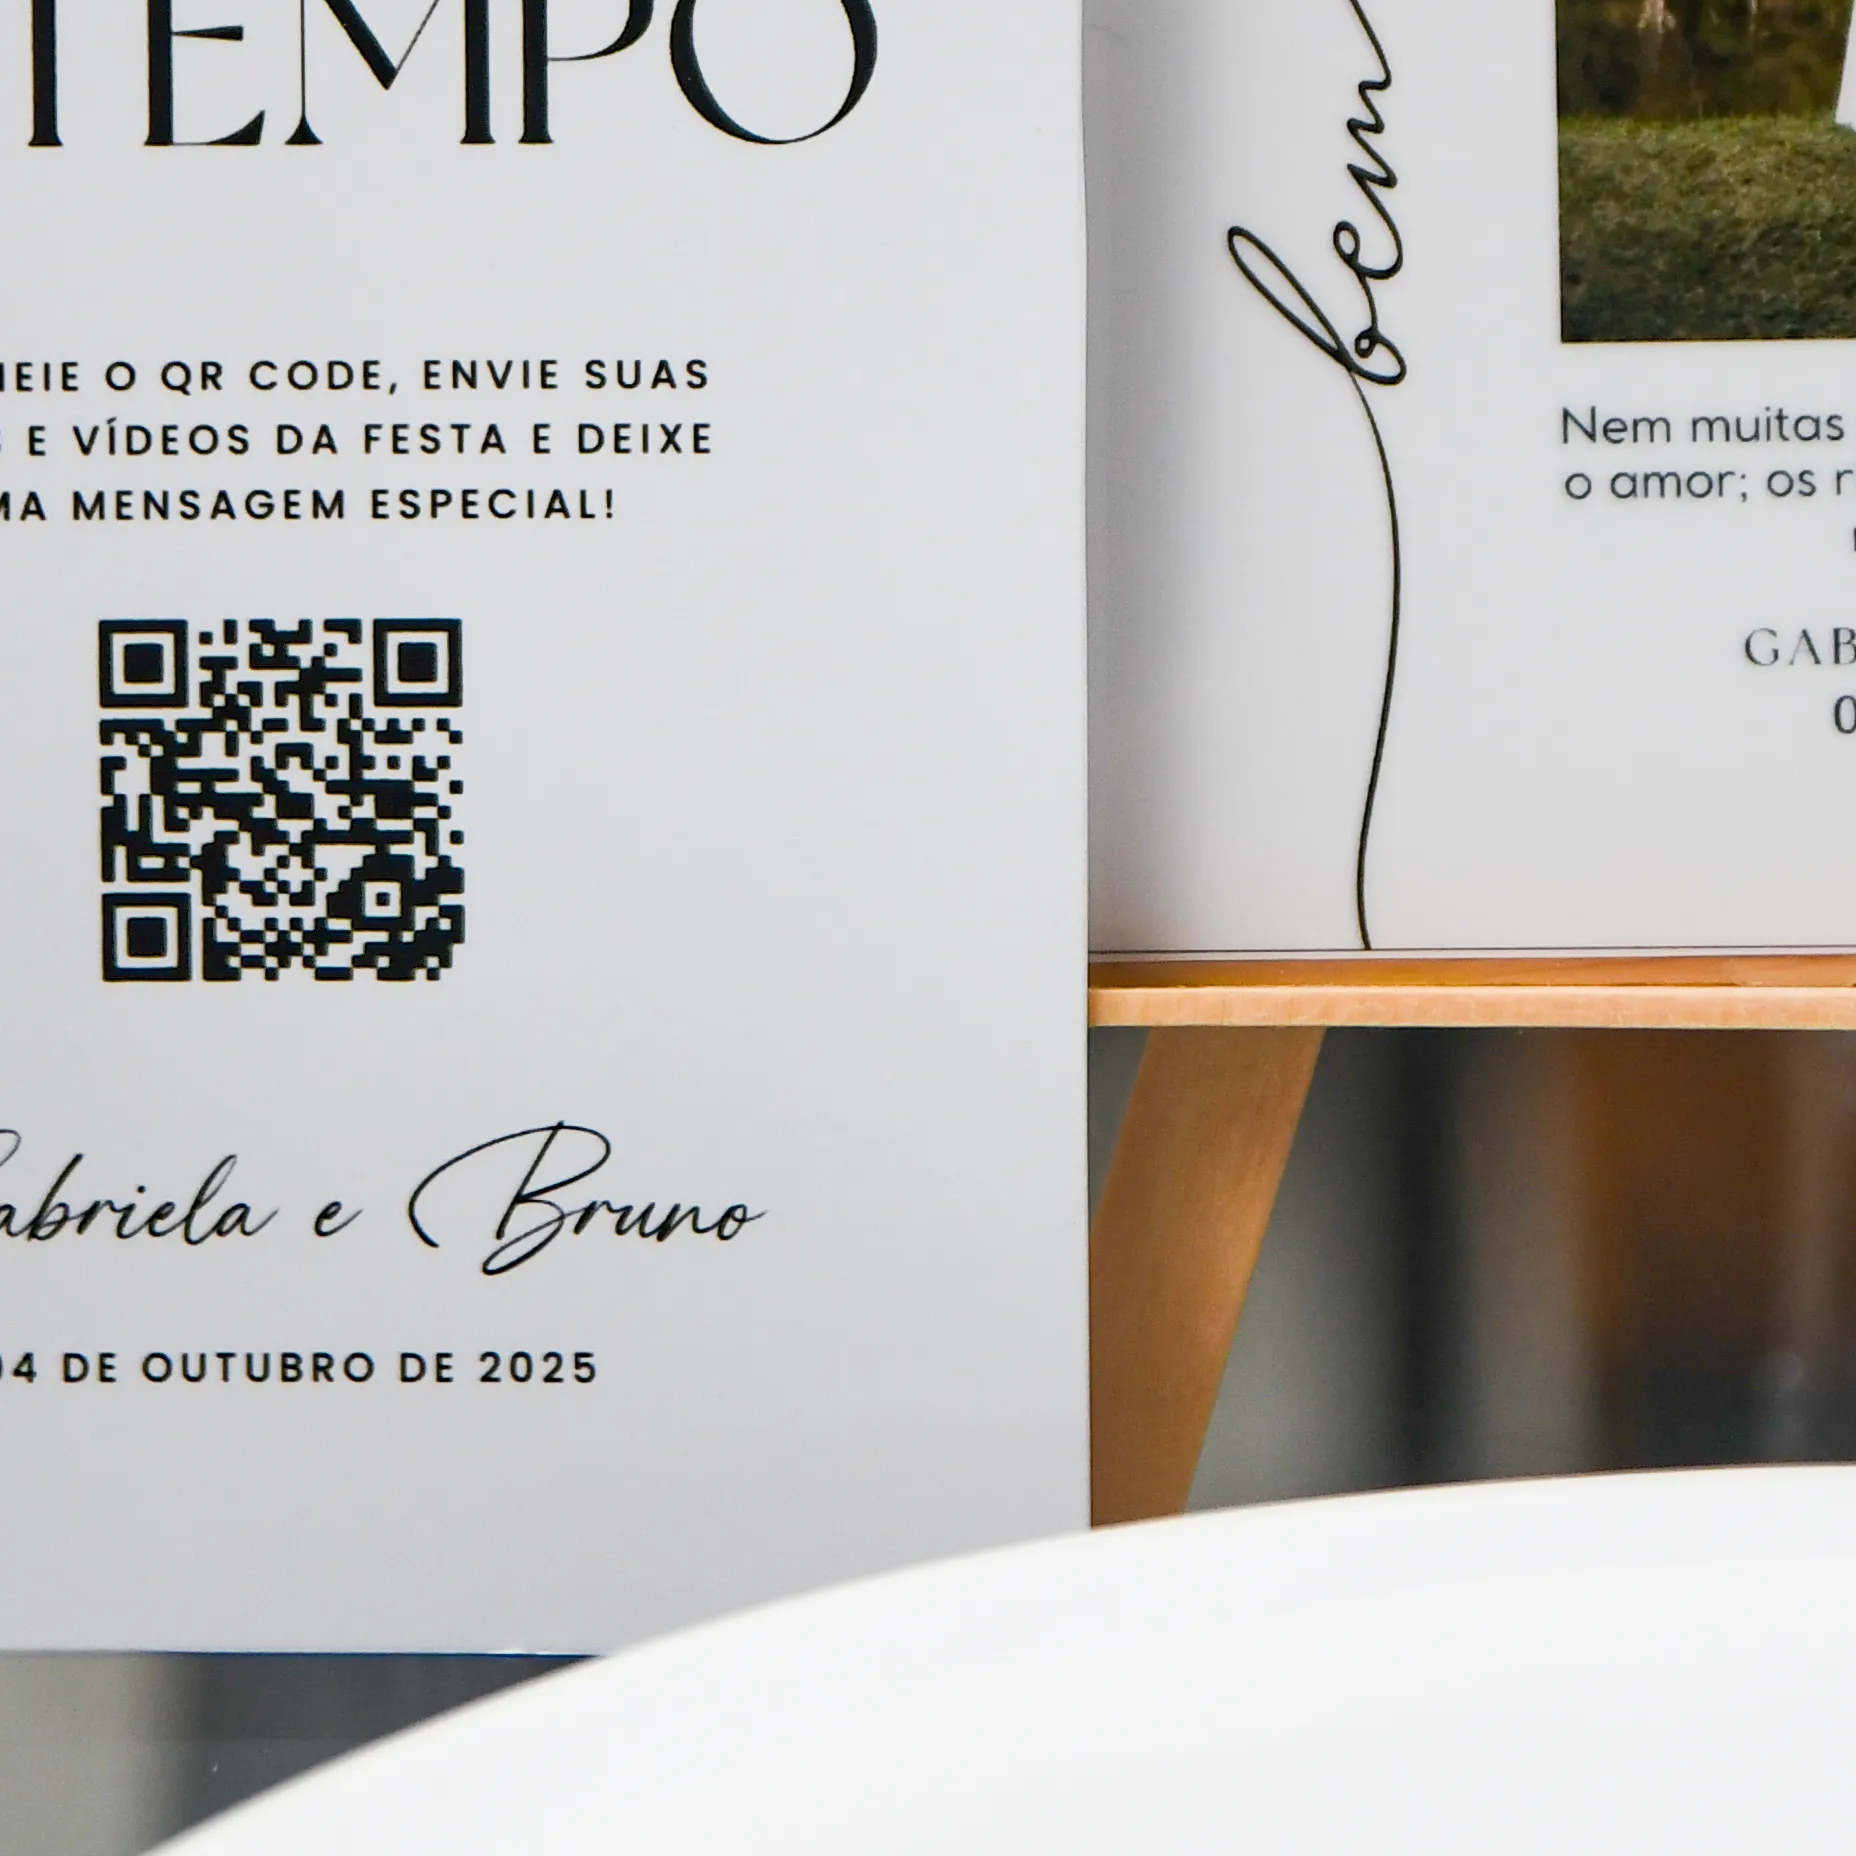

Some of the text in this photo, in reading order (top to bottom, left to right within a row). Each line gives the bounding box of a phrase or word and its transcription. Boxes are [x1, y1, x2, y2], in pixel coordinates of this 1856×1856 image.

[104, 360, 137, 392] O
[160, 360, 223, 397] QR
[248, 359, 398, 396] CODE,
[423, 359, 559, 391] ENVIE
[584, 358, 708, 390] SUAS
[27, 424, 47, 457] E
[71, 416, 250, 457] VÍDEOS
[275, 423, 339, 456] DA
[363, 423, 507, 455] FESTA
[532, 422, 551, 455] E
[577, 422, 711, 455] DEIXE
[1561, 405, 1672, 445] Nem
[1691, 406, 1845, 443] muitas
[72, 488, 345, 522] MENSAGEM
[371, 488, 614, 520] ESPECIAL!
[1564, 471, 1593, 501] o
[1609, 470, 1748, 503] amor;
[1766, 469, 1817, 499] os
[313, 1200, 363, 1238] e
[406, 1119, 767, 1277] Bruno
[61, 1351, 117, 1384] DE
[140, 1351, 375, 1384] OUTUBRO
[399, 1351, 454, 1384] DE
[478, 1350, 597, 1384] 2025
